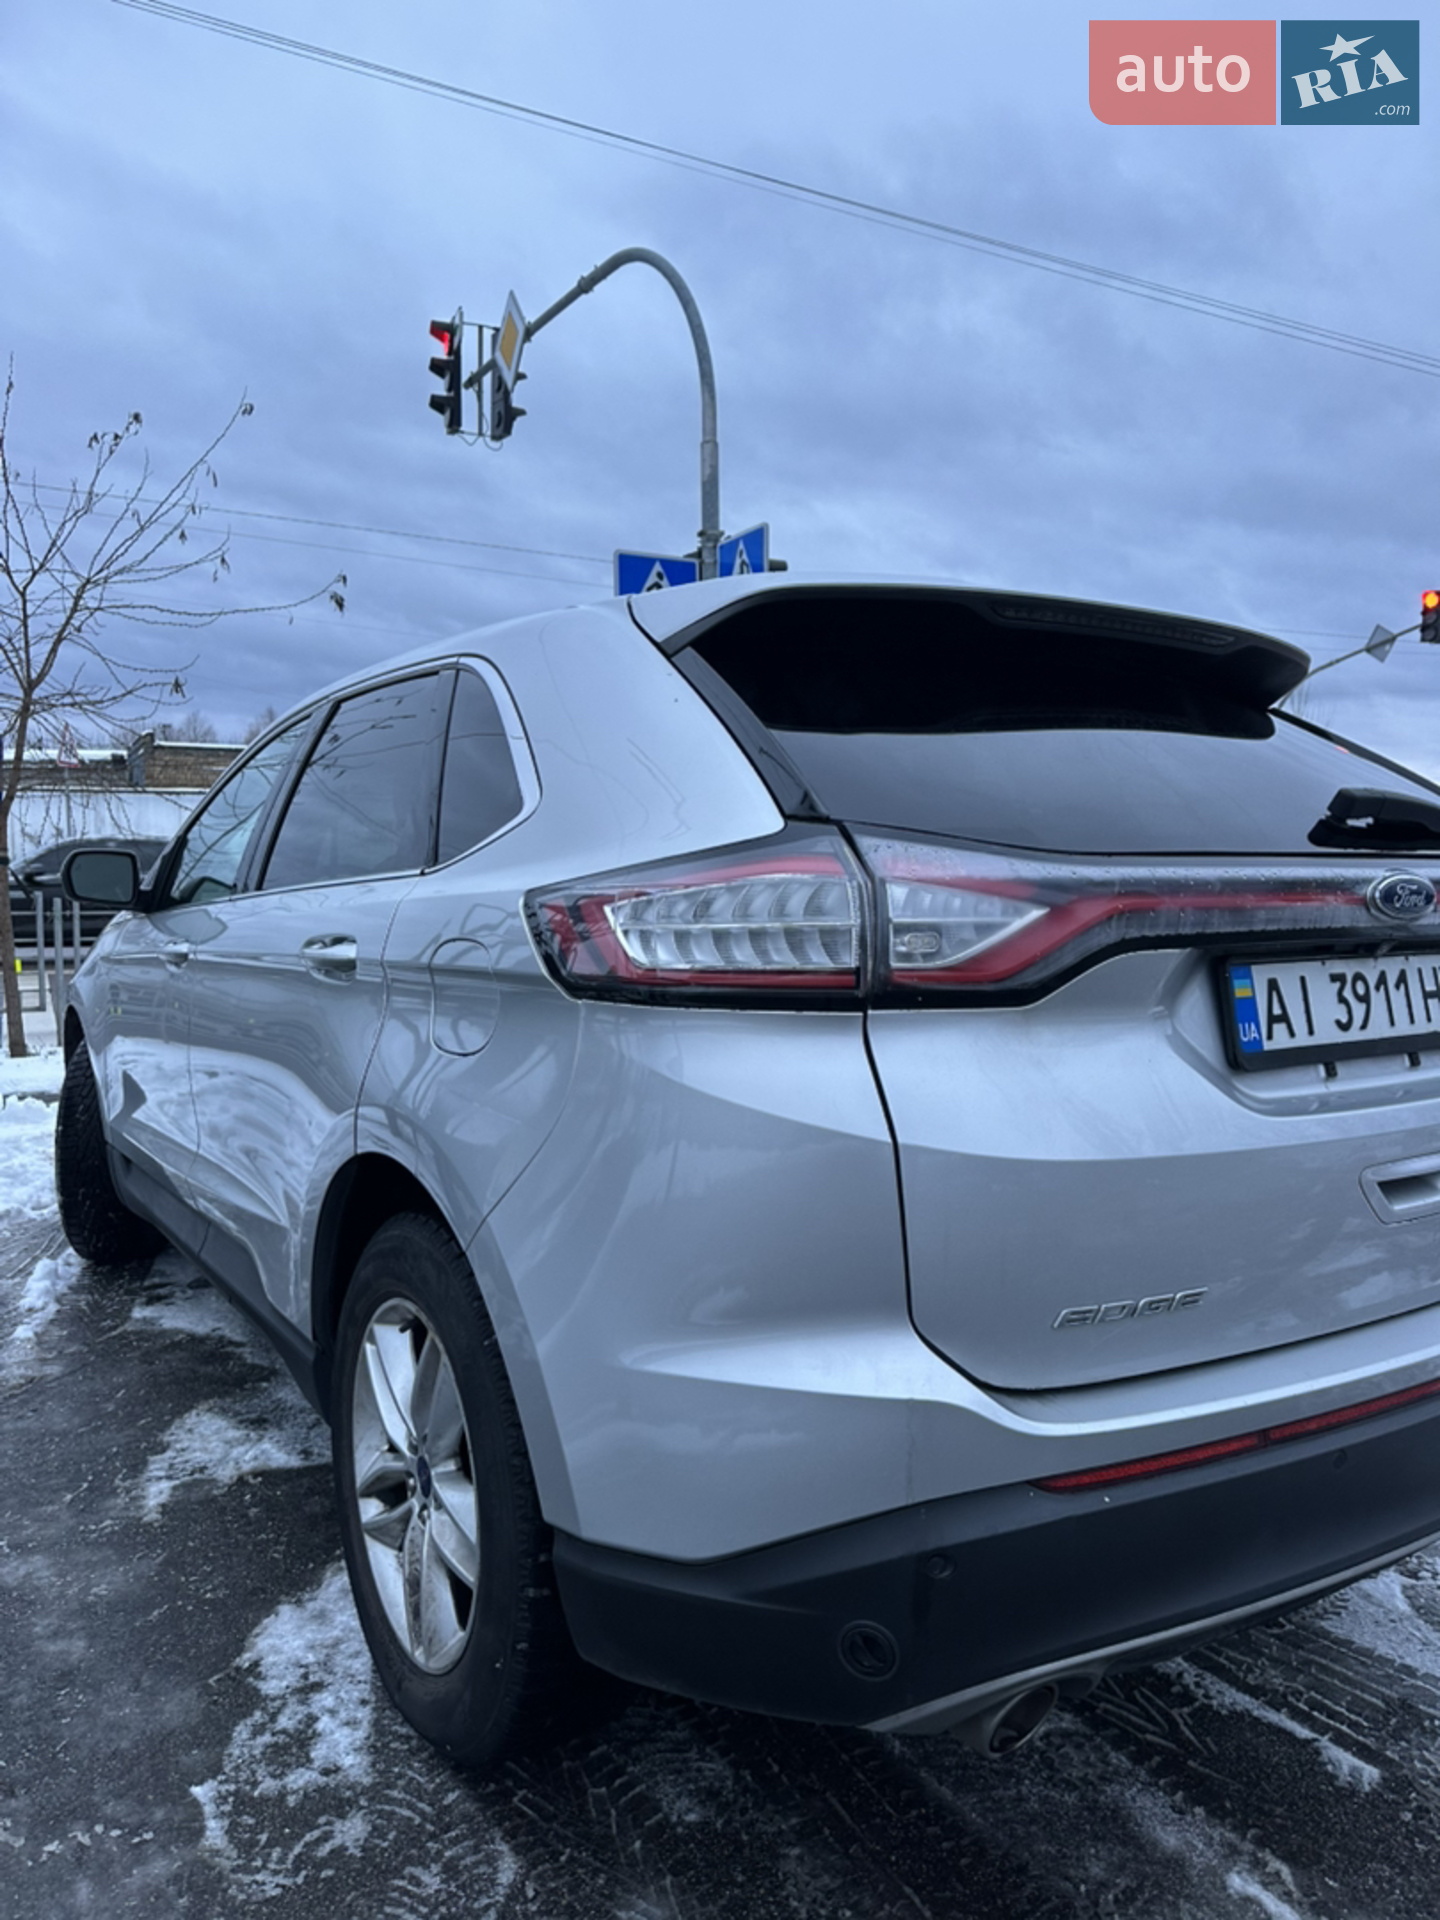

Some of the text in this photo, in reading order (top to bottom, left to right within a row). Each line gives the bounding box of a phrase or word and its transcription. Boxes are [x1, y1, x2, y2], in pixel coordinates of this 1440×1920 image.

[1393, 883, 1427, 908] Ford
[1266, 974, 1314, 1041] AI
[1238, 1022, 1260, 1042] UA
[1052, 1286, 1209, 1329] EDGE
